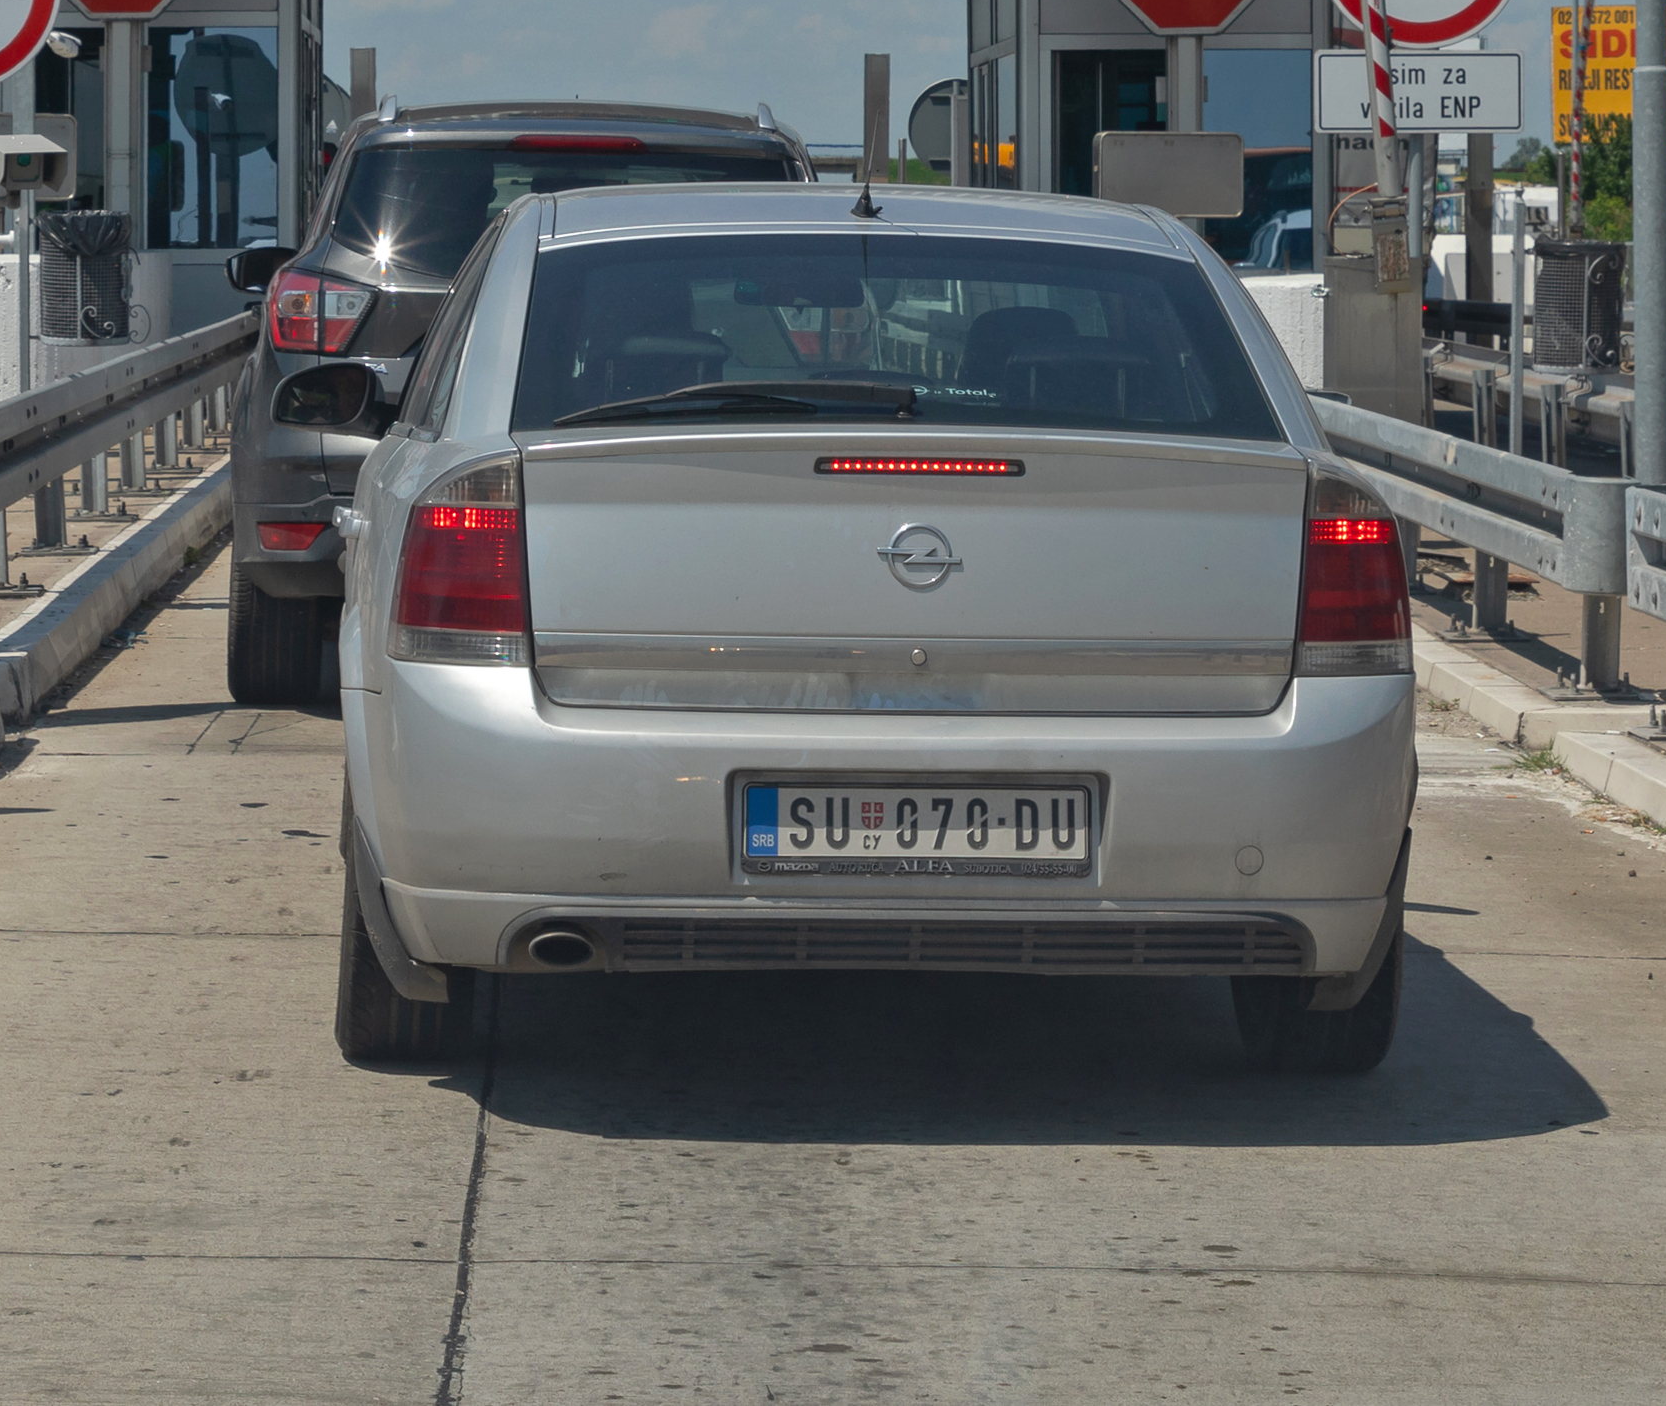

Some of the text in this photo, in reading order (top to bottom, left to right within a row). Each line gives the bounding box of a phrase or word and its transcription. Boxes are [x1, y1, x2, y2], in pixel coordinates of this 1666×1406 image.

[1391, 63, 1467, 85] sim za
[1360, 96, 1481, 119] vila ENP
[790, 797, 850, 850] SU
[752, 833, 775, 847] SRB
[894, 859, 956, 874] ALFA
[964, 863, 1012, 874] SUBOTICA
